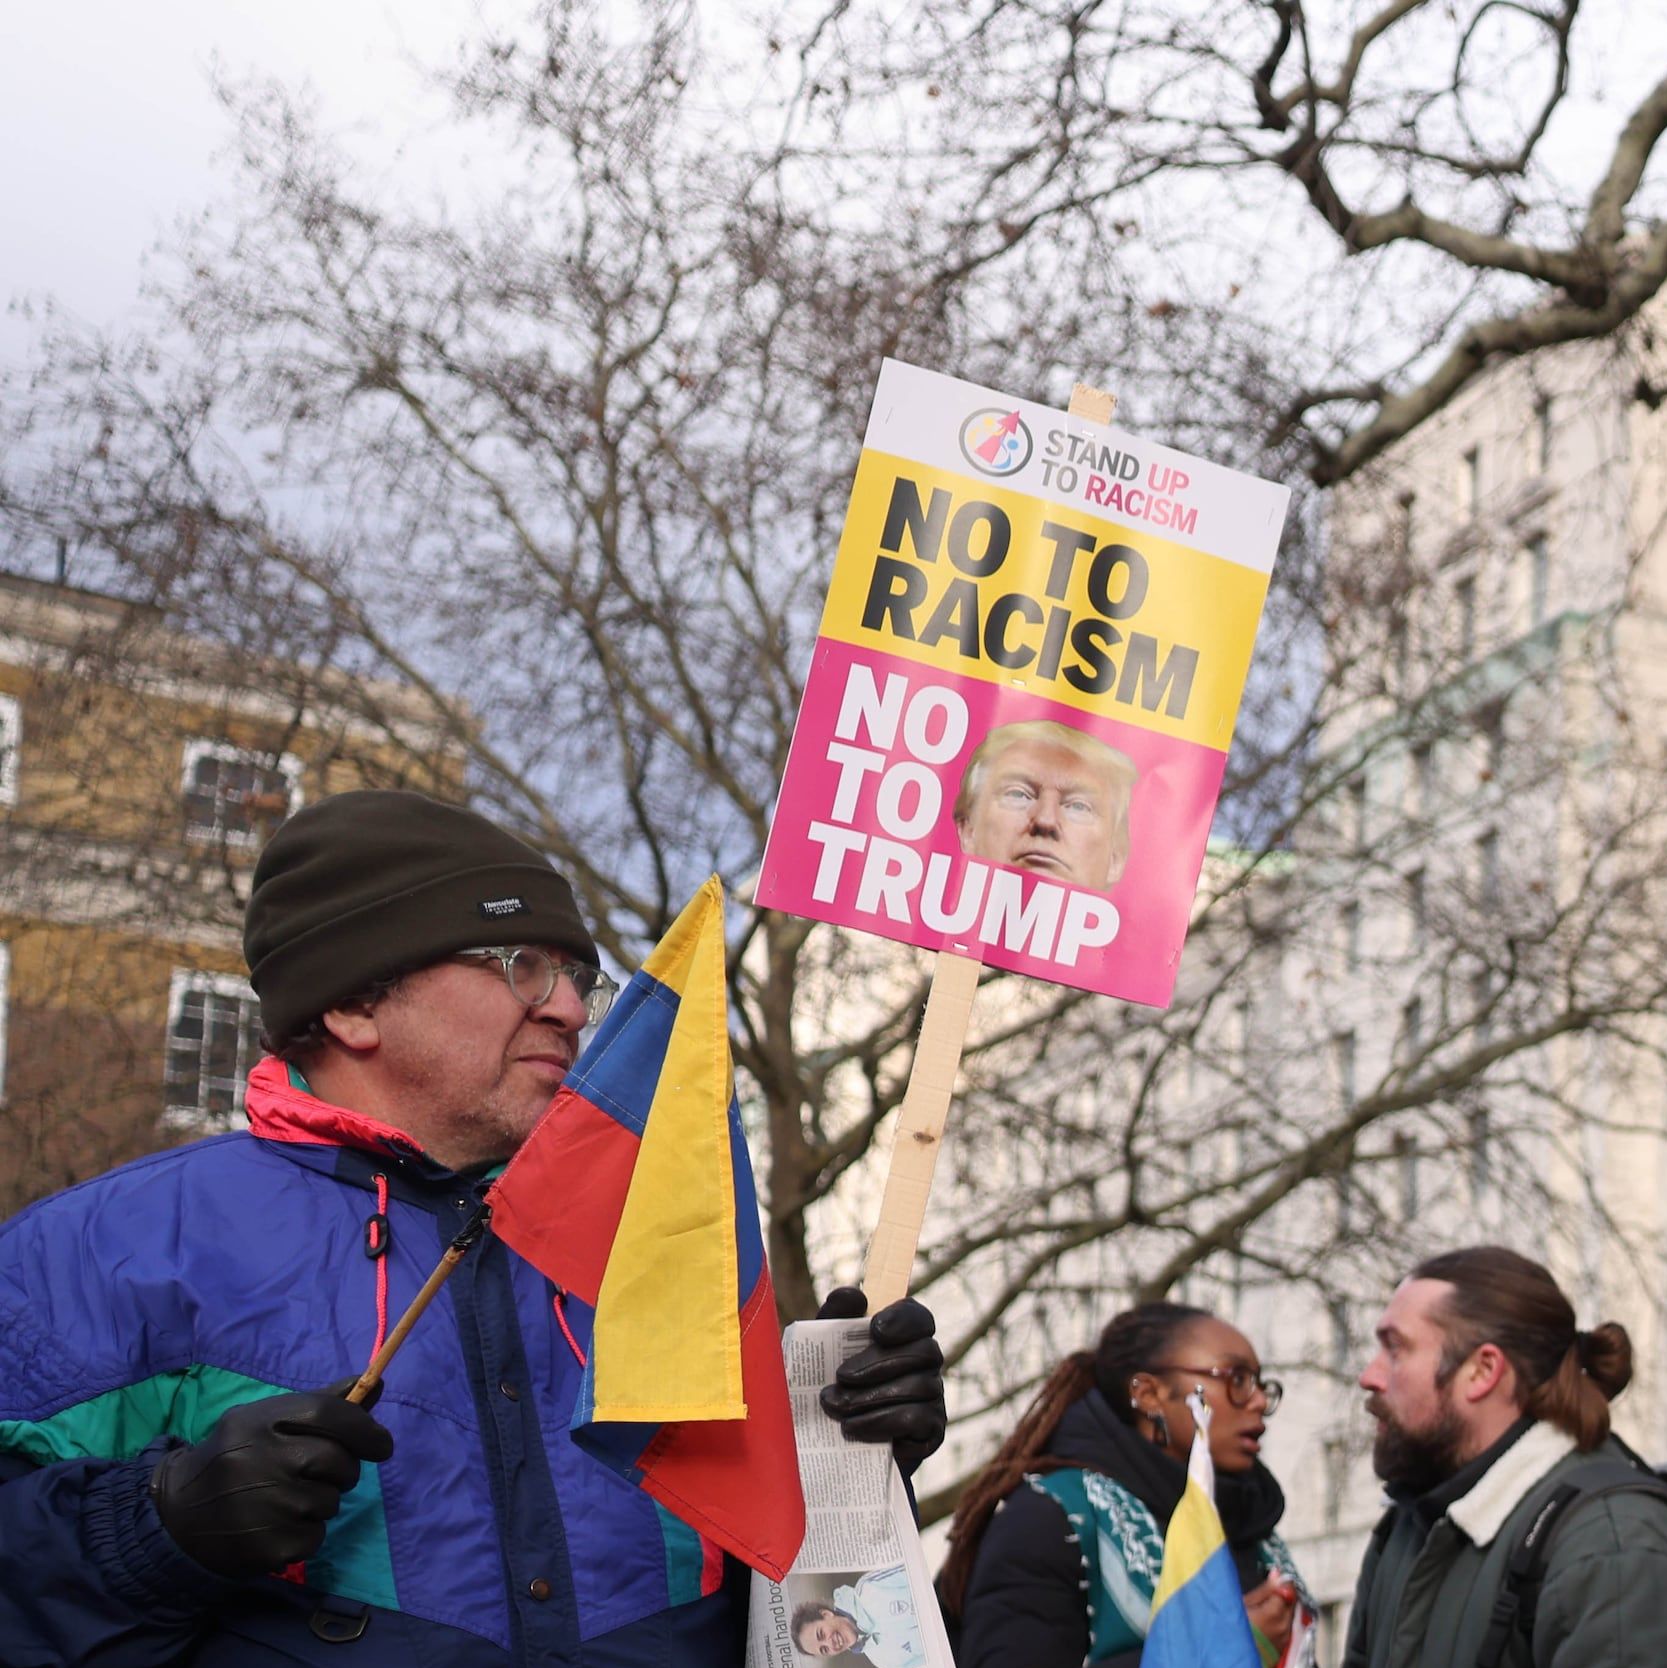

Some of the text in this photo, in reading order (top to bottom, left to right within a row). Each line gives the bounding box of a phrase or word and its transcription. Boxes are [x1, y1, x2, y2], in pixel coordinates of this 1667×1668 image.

[1041, 459, 1198, 535] TO RACISM
[1045, 429, 1190, 495] STAND UP
[880, 476, 1149, 621] NO TO
[861, 555, 1199, 721] RACISM
[835, 662, 969, 765] NO
[826, 740, 942, 841] TO
[807, 820, 1120, 967] TRUMP
[769, 1605, 789, 1639] hand
